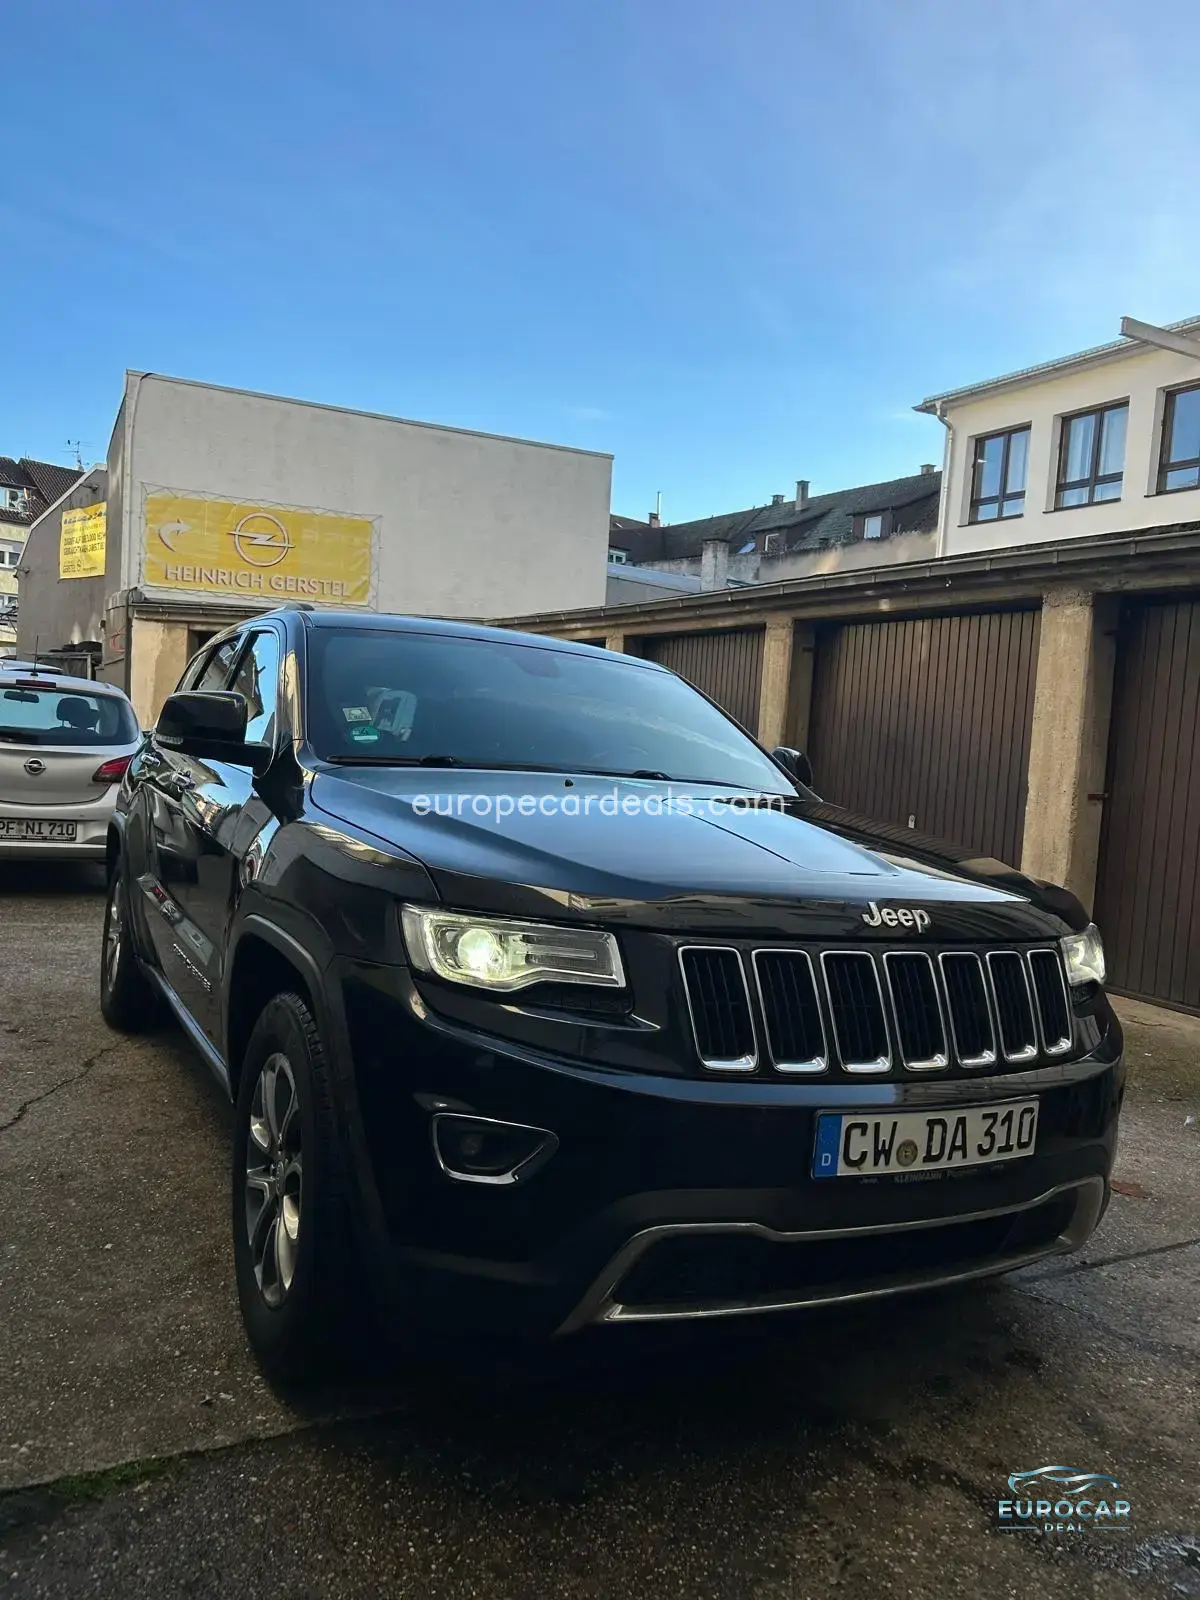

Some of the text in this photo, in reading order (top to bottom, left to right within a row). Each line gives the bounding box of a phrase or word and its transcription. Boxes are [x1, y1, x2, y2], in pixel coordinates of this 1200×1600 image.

[165, 563, 351, 597] HEINRICH GERSTEL
[25, 821, 44, 835] NI
[48, 822, 75, 836] 710
[861, 901, 931, 934] Jeep
[842, 1106, 1036, 1168] CW DA 310
[821, 1153, 832, 1167] D
